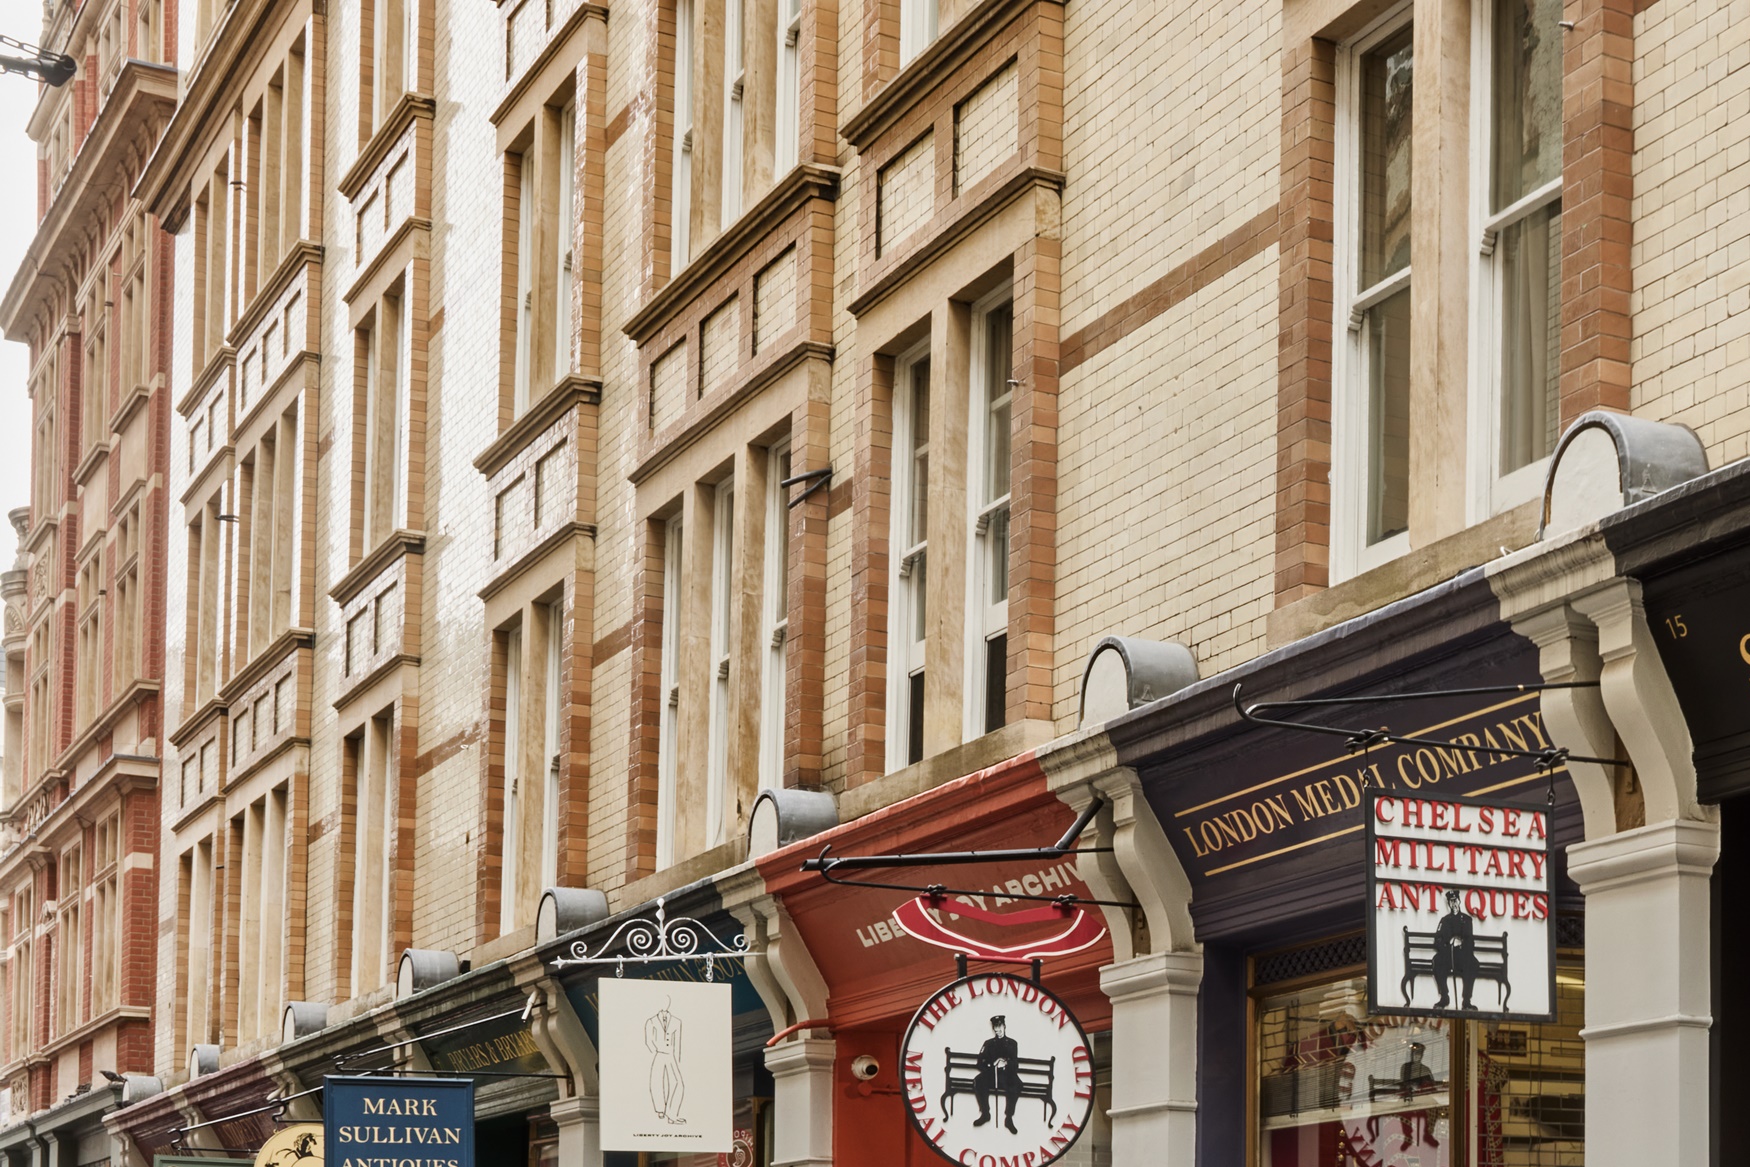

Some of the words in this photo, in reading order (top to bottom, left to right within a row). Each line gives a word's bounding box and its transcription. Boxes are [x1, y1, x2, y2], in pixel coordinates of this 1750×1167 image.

[1665, 613, 1688, 640] 15
[1183, 794, 1295, 858] LONDON
[1291, 763, 1396, 823] MEDAL
[1397, 711, 1549, 789] COMPANY
[1375, 795, 1547, 839] CHELSEA
[1375, 838, 1547, 880] MILITARY
[856, 906, 943, 948] LIBEY
[950, 889, 989, 921] OY
[1376, 881, 1549, 921] ANTQUES
[917, 987, 963, 1032] THE
[967, 977, 1071, 1030] LONDON
[362, 1097, 438, 1116] MARK
[904, 1049, 947, 1149] MEDAL
[1072, 1045, 1093, 1100] LTD
[339, 1126, 461, 1144] SULLIVAN
